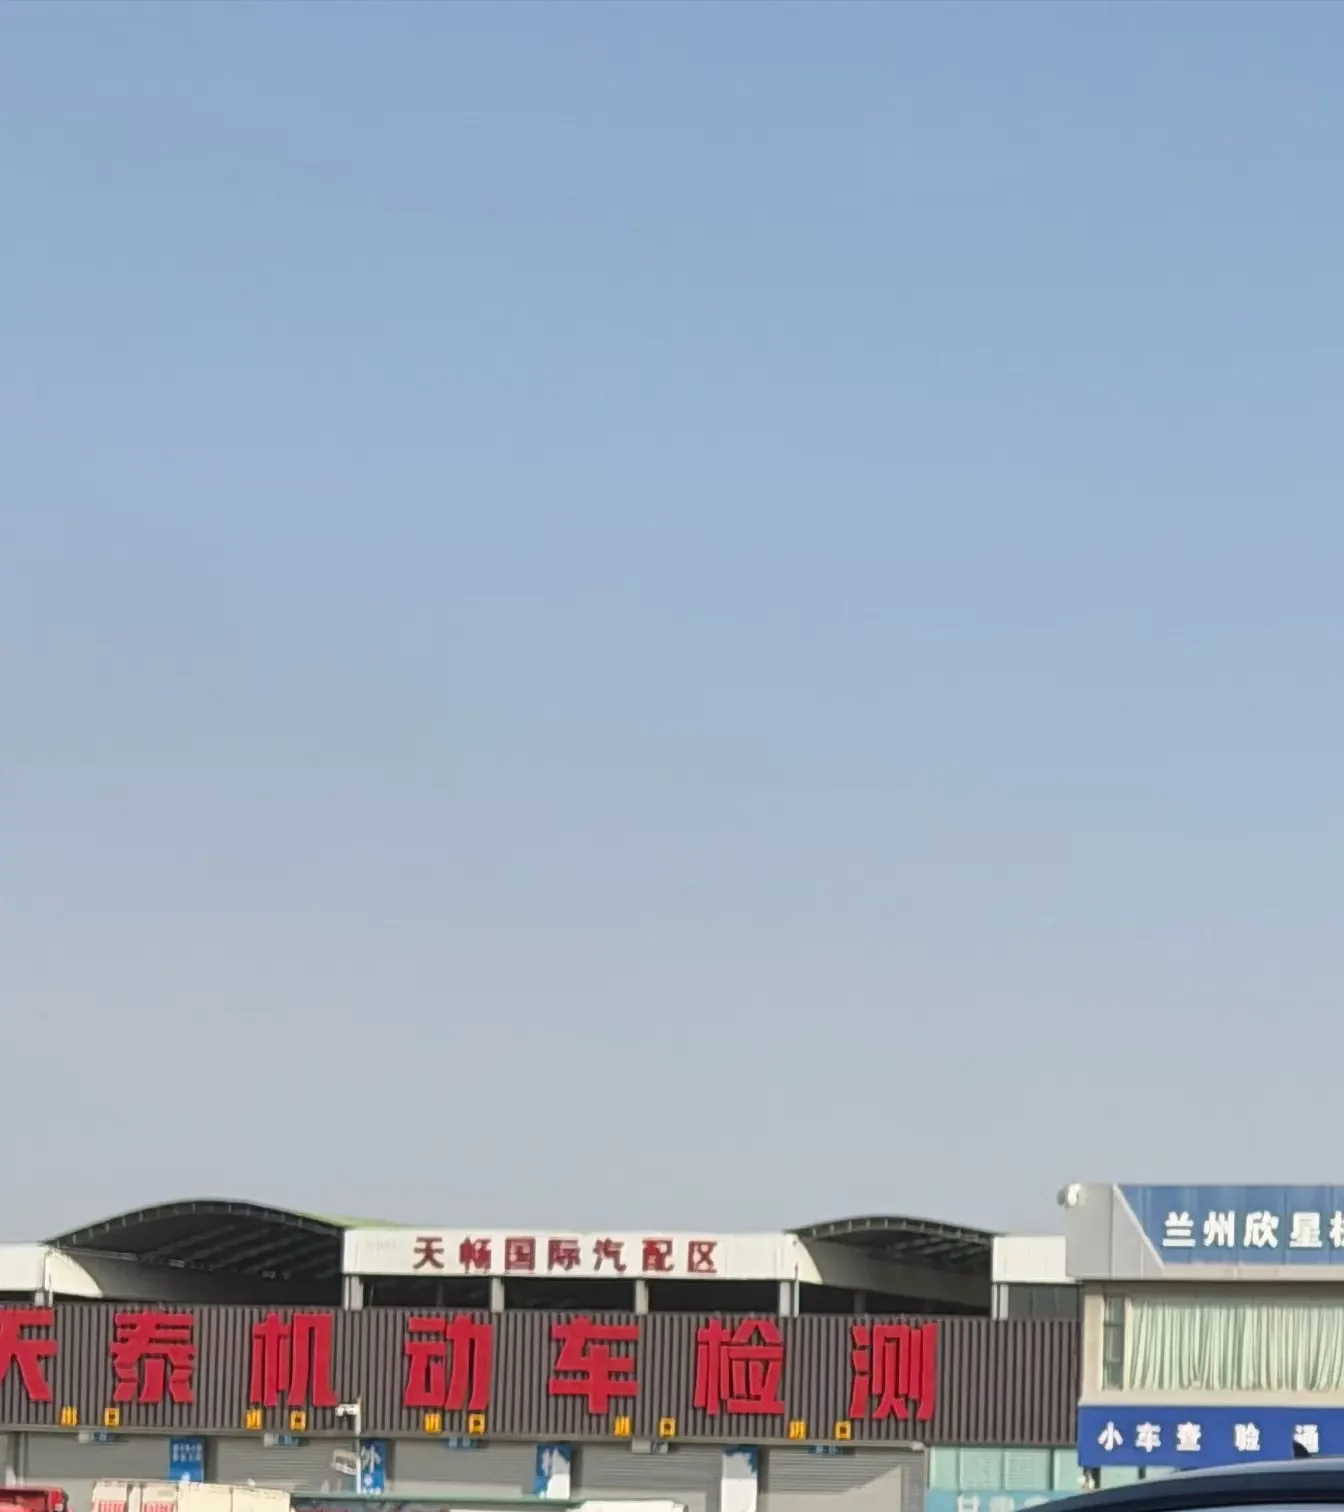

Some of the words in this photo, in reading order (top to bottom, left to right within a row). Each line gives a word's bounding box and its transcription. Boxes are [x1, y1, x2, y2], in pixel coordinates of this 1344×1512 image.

[412, 1235, 718, 1274] 天畅国际汽配区
[0, 1308, 939, 1422] 天泰机动车检测
